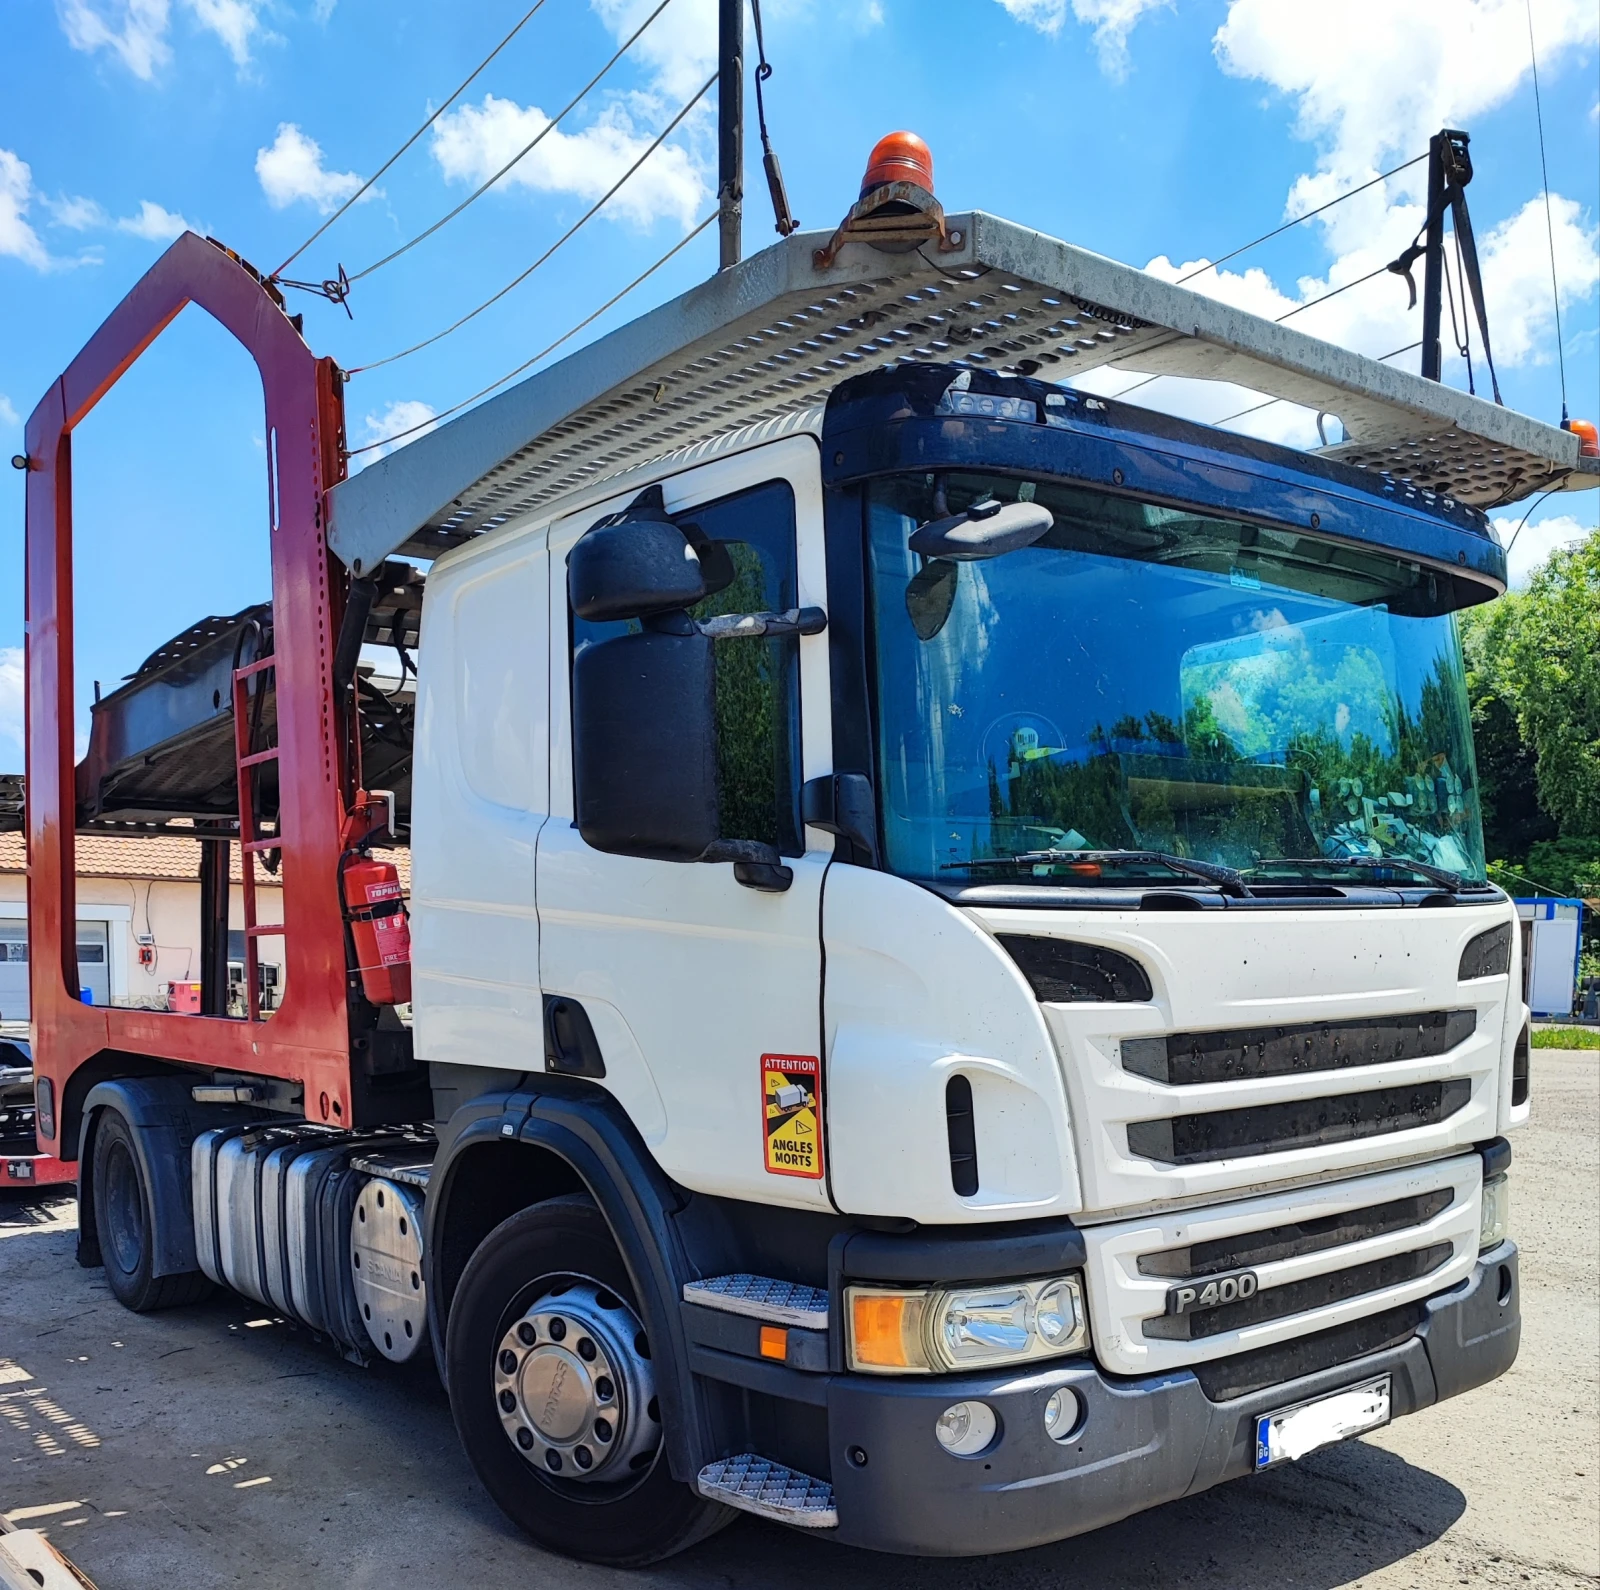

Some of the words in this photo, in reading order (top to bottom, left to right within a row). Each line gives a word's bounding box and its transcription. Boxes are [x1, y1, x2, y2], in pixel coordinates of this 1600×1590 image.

[765, 1058, 816, 1071] ATTENTION
[773, 1139, 813, 1154] ANGLES
[775, 1152, 812, 1167] MORTS
[367, 1259, 402, 1284] SCANIA
[1176, 1288, 1196, 1314] P
[1199, 1274, 1257, 1306] 400
[541, 1359, 569, 1427] SCANIA
[1258, 1446, 1269, 1459] BG
